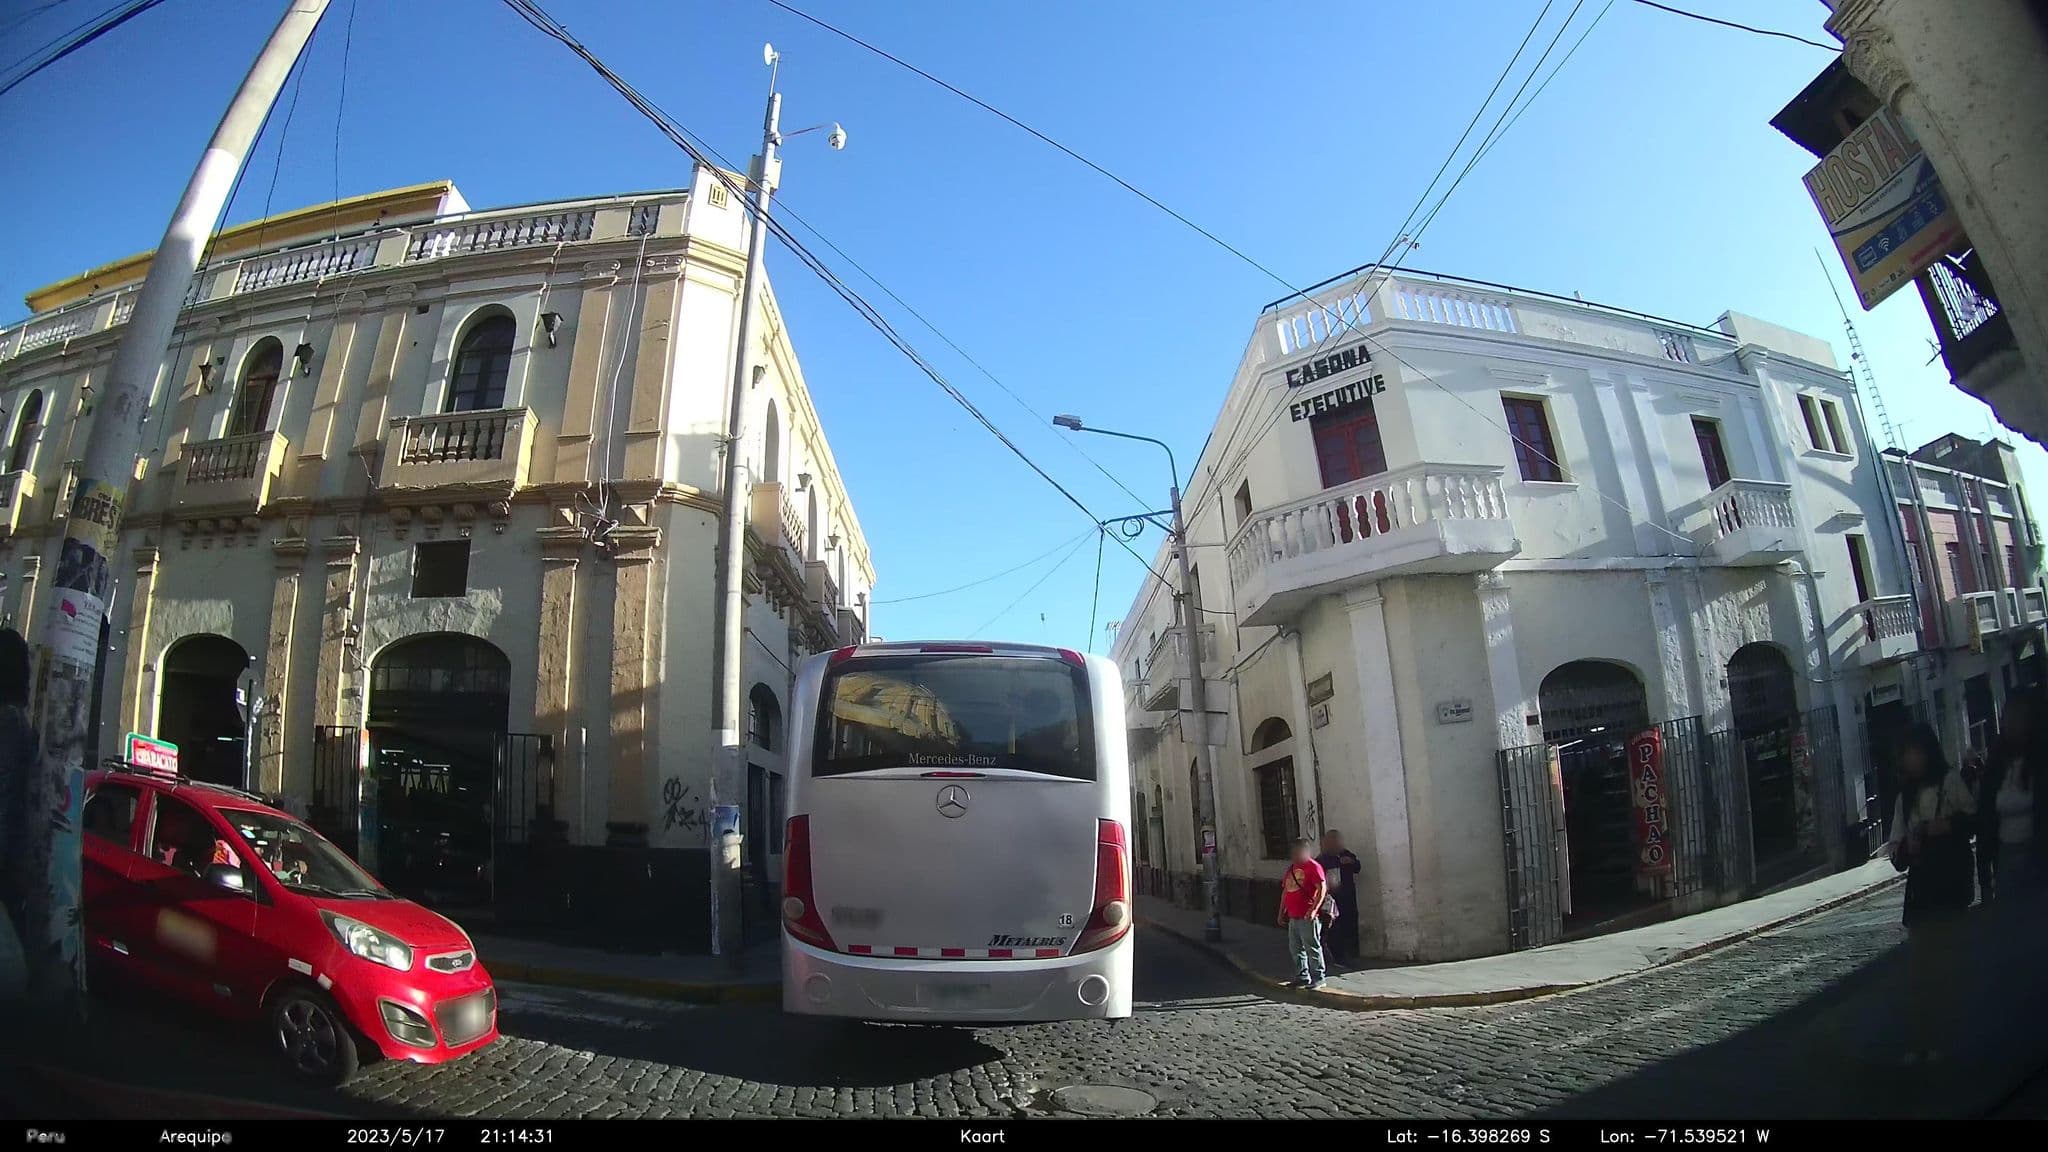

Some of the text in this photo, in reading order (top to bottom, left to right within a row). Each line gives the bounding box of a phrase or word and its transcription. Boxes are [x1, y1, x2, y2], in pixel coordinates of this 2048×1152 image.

[1806, 109, 1923, 225] HOSTAL
[1286, 345, 1372, 389] CASONA
[1290, 374, 1386, 422] EJECUTIVE
[908, 752, 997, 766] Mercedes-Benz
[1639, 743, 1664, 863] PACHAO
[987, 934, 1068, 946] METALBUS
[1059, 914, 1073, 925] 18
